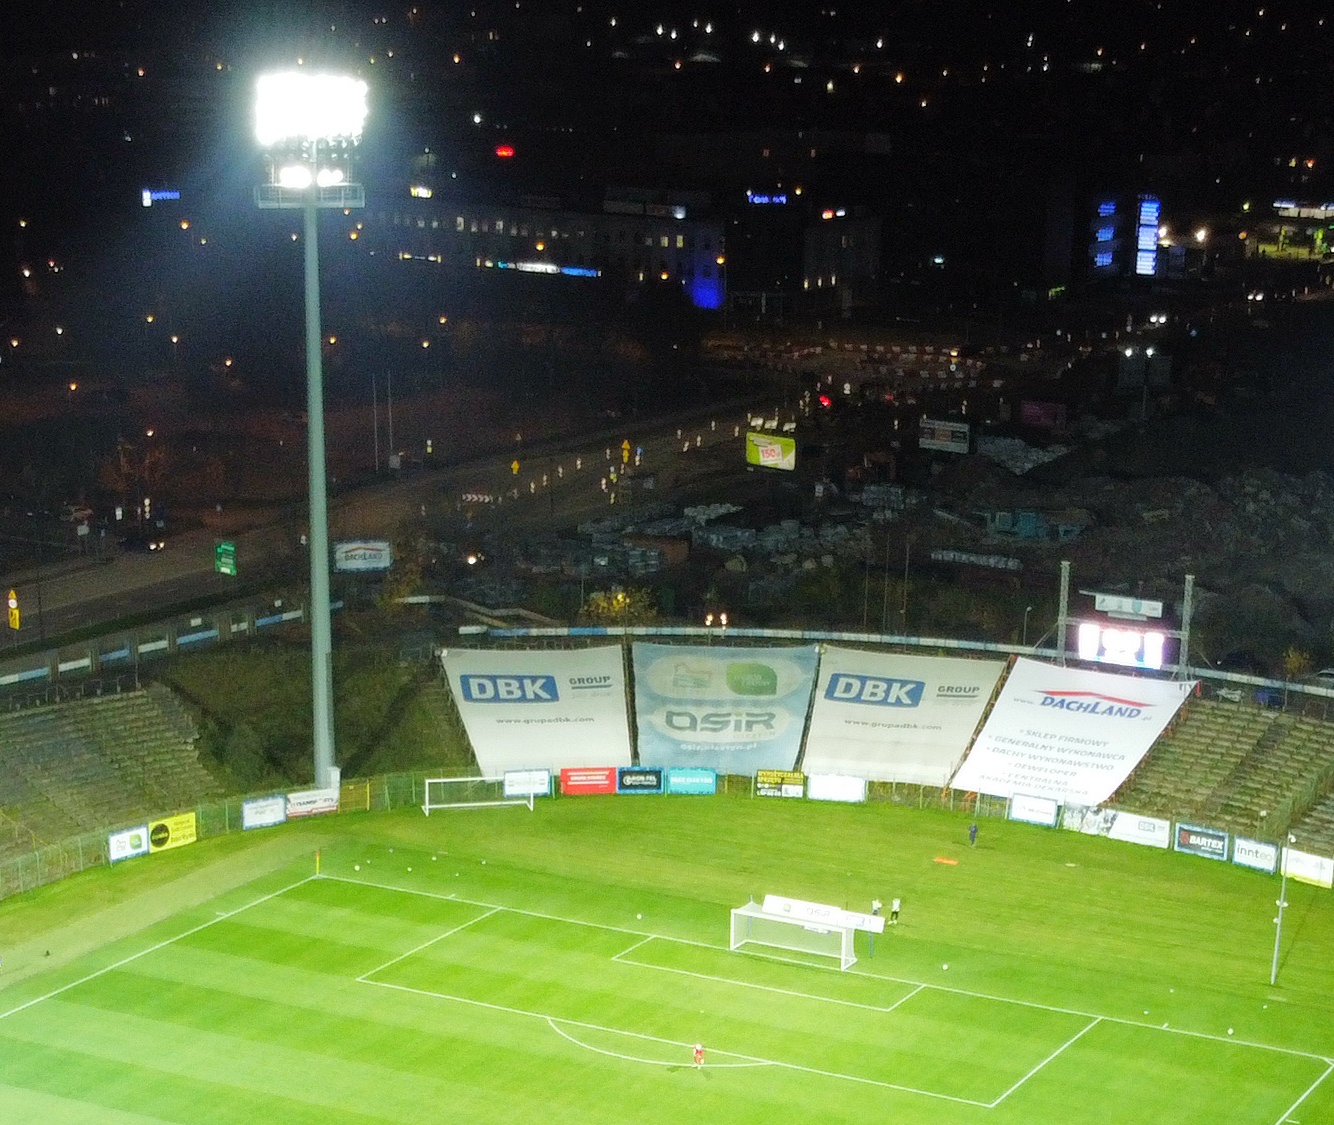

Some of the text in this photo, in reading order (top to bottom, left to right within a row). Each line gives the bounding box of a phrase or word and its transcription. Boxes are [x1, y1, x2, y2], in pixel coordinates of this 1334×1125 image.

[469, 677, 552, 701] DBK
[569, 675, 612, 686] GROUP
[833, 677, 916, 705] DBK
[937, 685, 981, 694] GROUP
[1040, 696, 1142, 719] DACHLAND
[994, 735, 1126, 761] GENERALNY WYKONAWCA
[1025, 729, 1110, 747] SKLEP FIRMOWY
[991, 746, 1114, 771] DACHY WYKONAWSTWO
[1014, 762, 1078, 777] DEWELOPER
[1188, 834, 1224, 850] BARTEX
